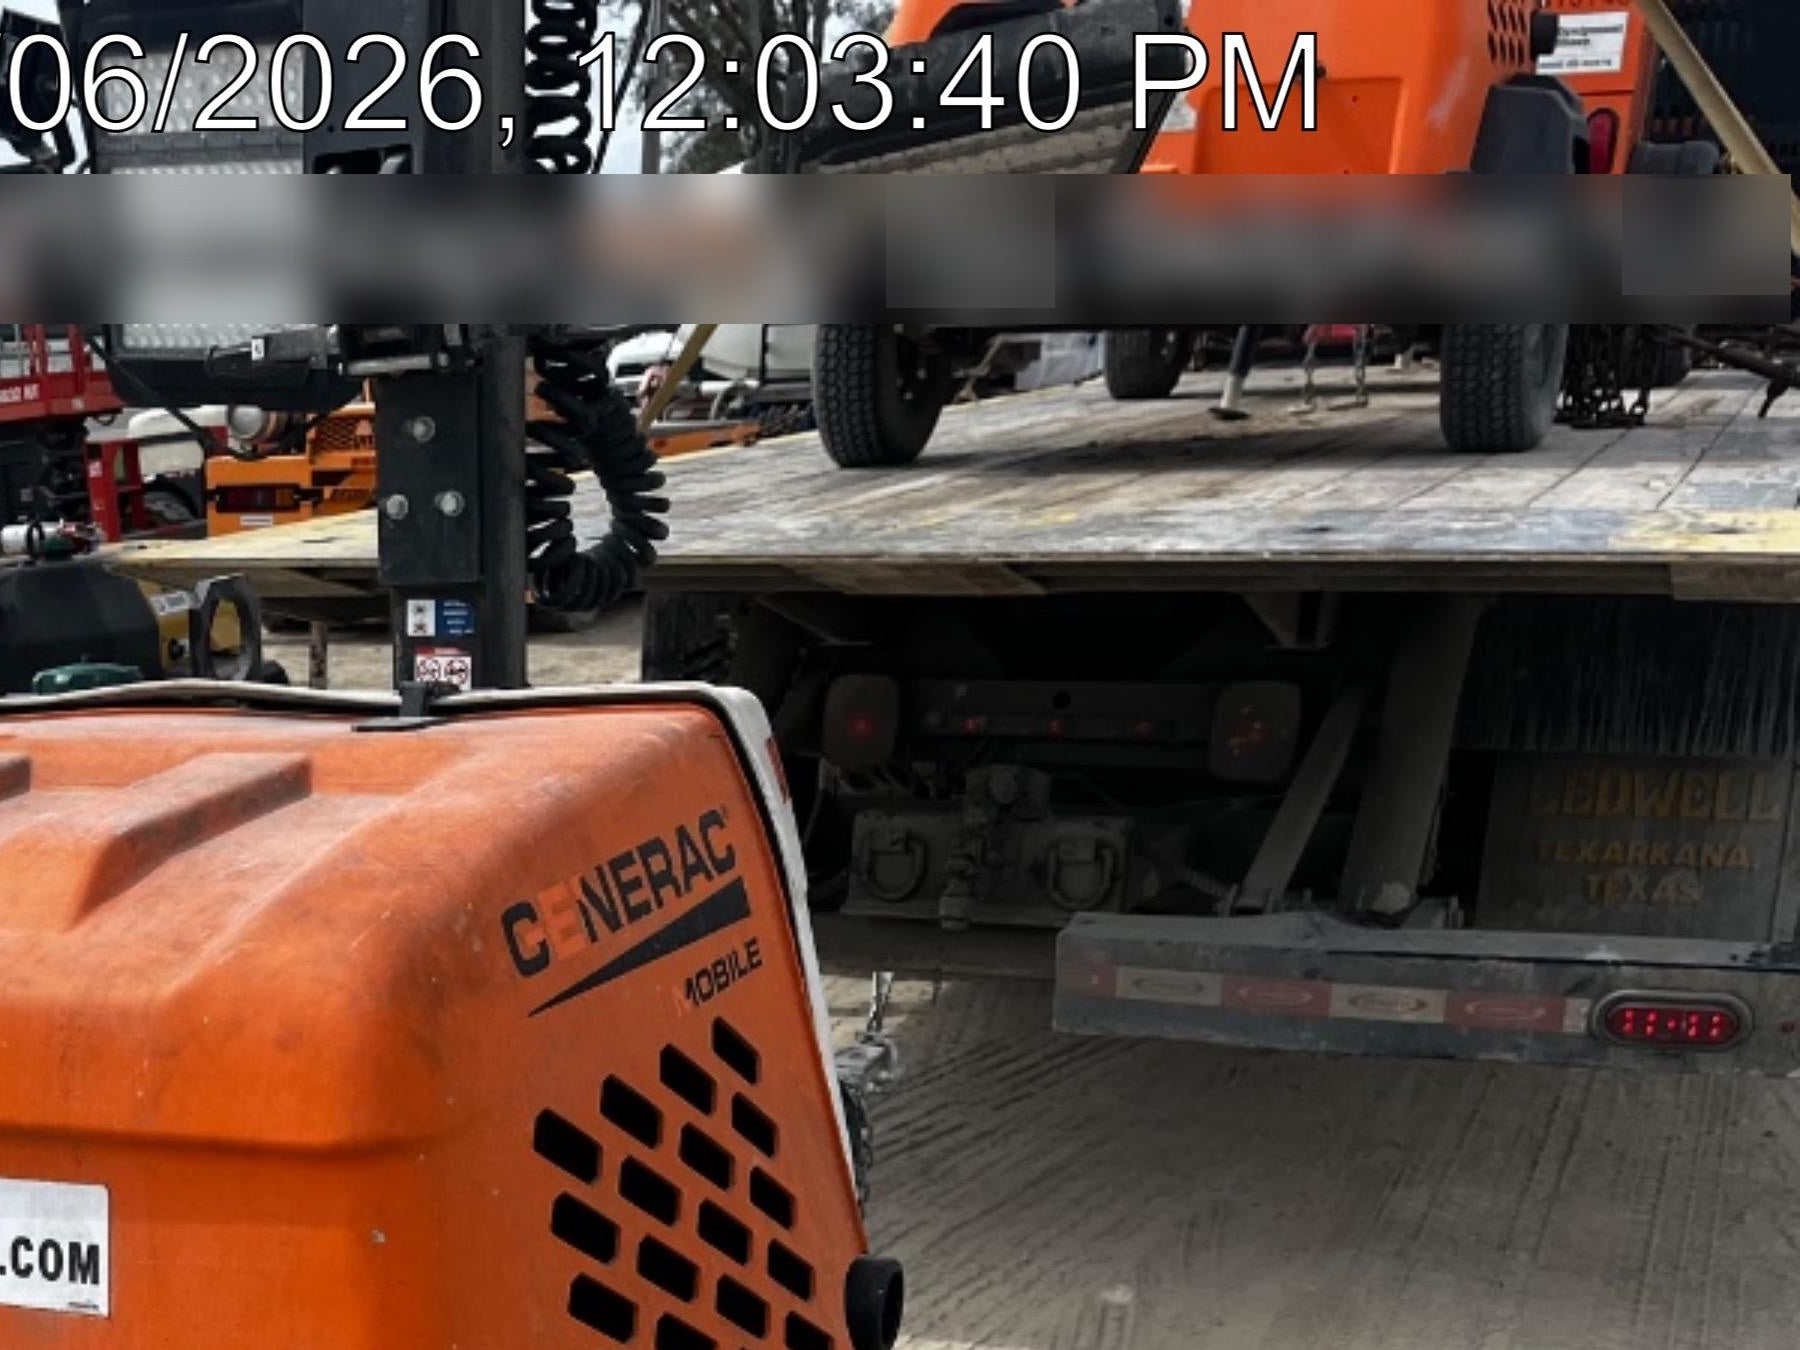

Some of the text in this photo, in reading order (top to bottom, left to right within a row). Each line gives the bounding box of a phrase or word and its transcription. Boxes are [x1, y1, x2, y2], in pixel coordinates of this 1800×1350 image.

[1528, 766, 1783, 821] LEDWELL
[501, 808, 736, 977] GENERAC
[1586, 870, 1704, 905] TEXAS
